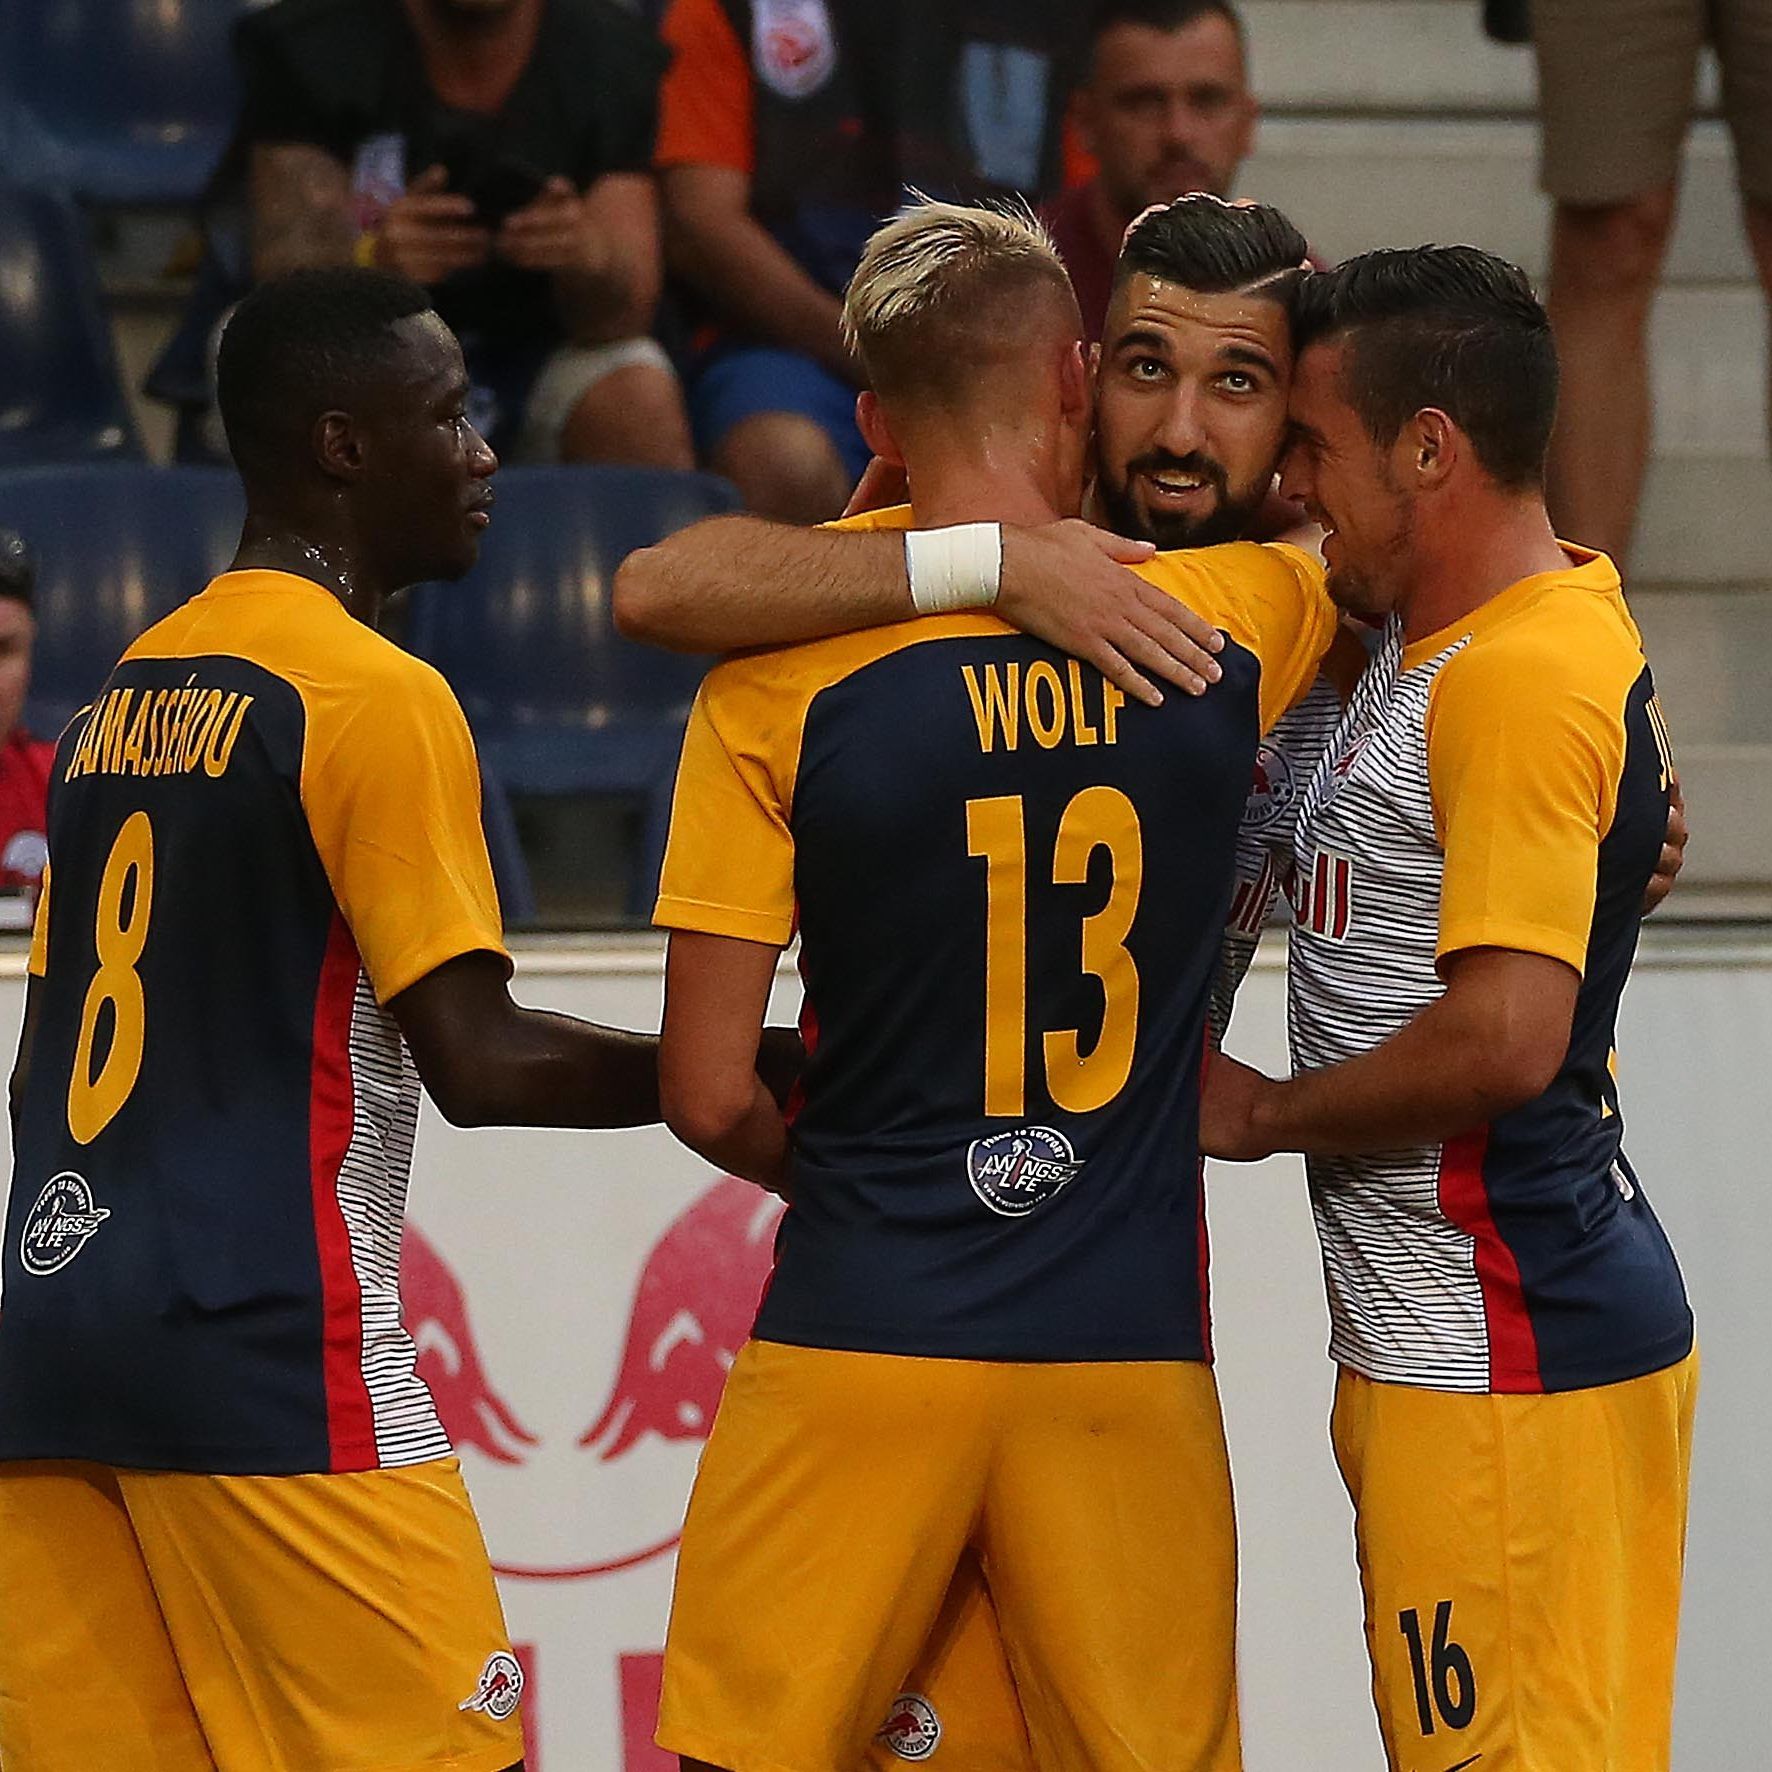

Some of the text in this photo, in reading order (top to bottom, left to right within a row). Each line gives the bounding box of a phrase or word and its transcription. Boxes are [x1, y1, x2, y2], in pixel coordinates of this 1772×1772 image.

[64, 672, 255, 783] AMASSÉKOU
[960, 659, 1125, 753] WOLF
[67, 810, 154, 1145] 8
[965, 785, 1143, 1117] 13
[993, 1154, 1064, 1180] WINGS
[1398, 1600, 1477, 1737] 16
